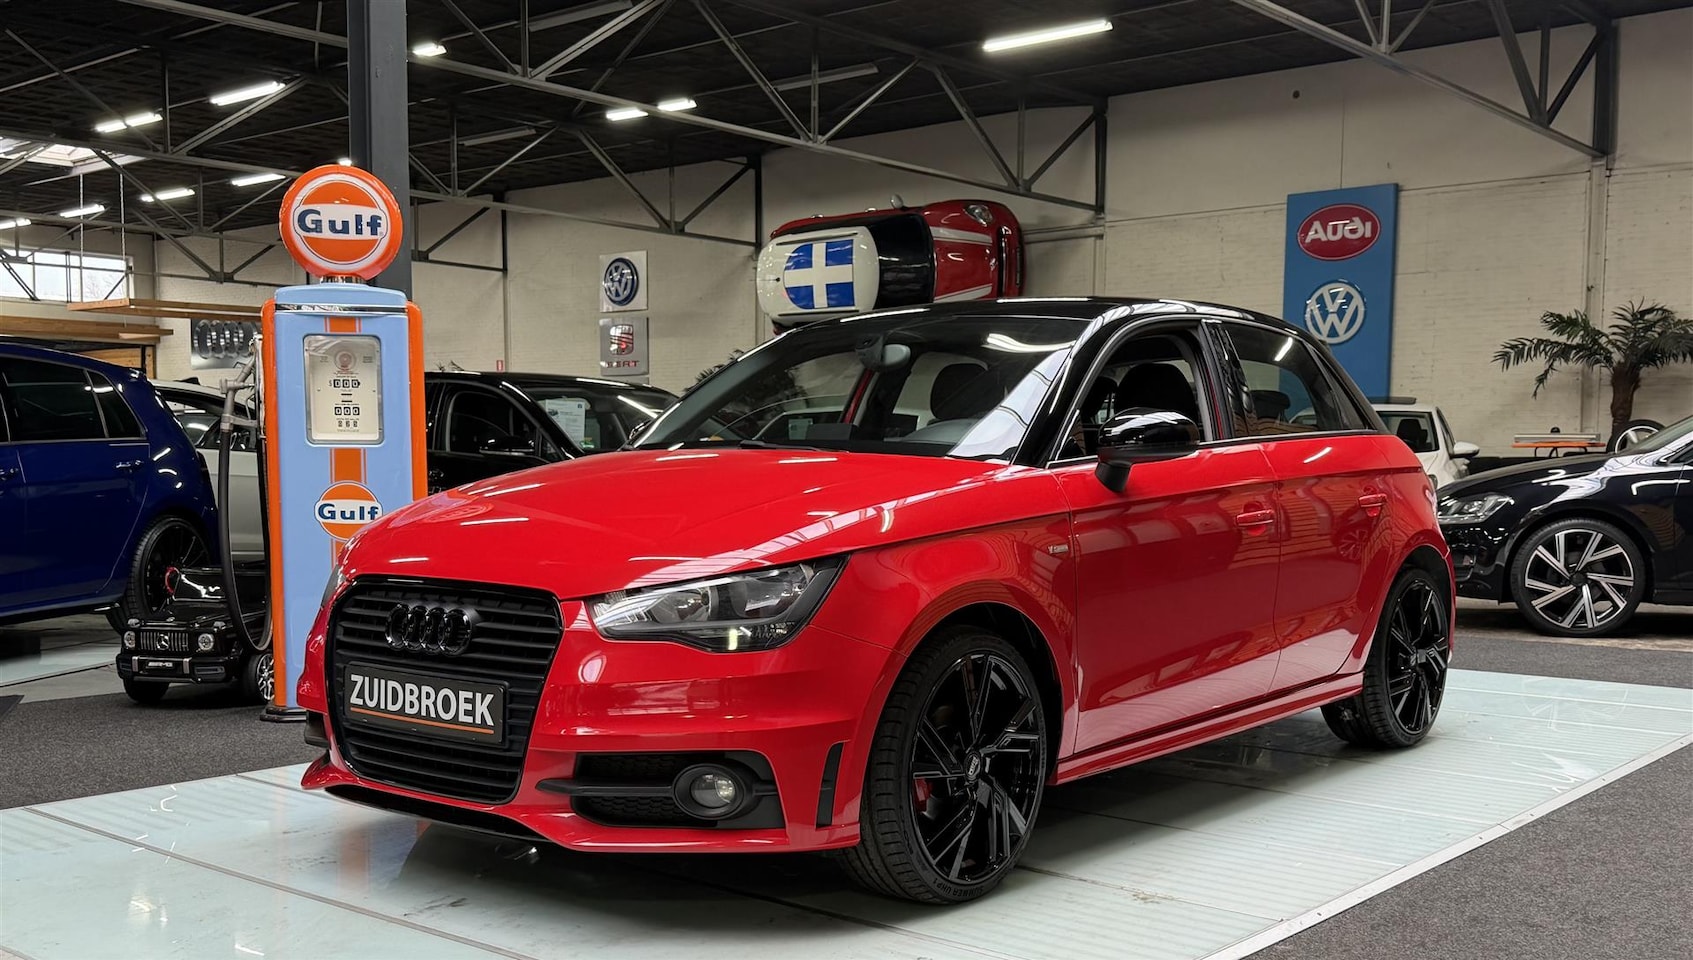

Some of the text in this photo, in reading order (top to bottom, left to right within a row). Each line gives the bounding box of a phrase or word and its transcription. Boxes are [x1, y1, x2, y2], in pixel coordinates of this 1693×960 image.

[297, 208, 382, 236] Gulf
[318, 503, 379, 520] Gulf
[349, 674, 495, 727] ZUIDBROEK
